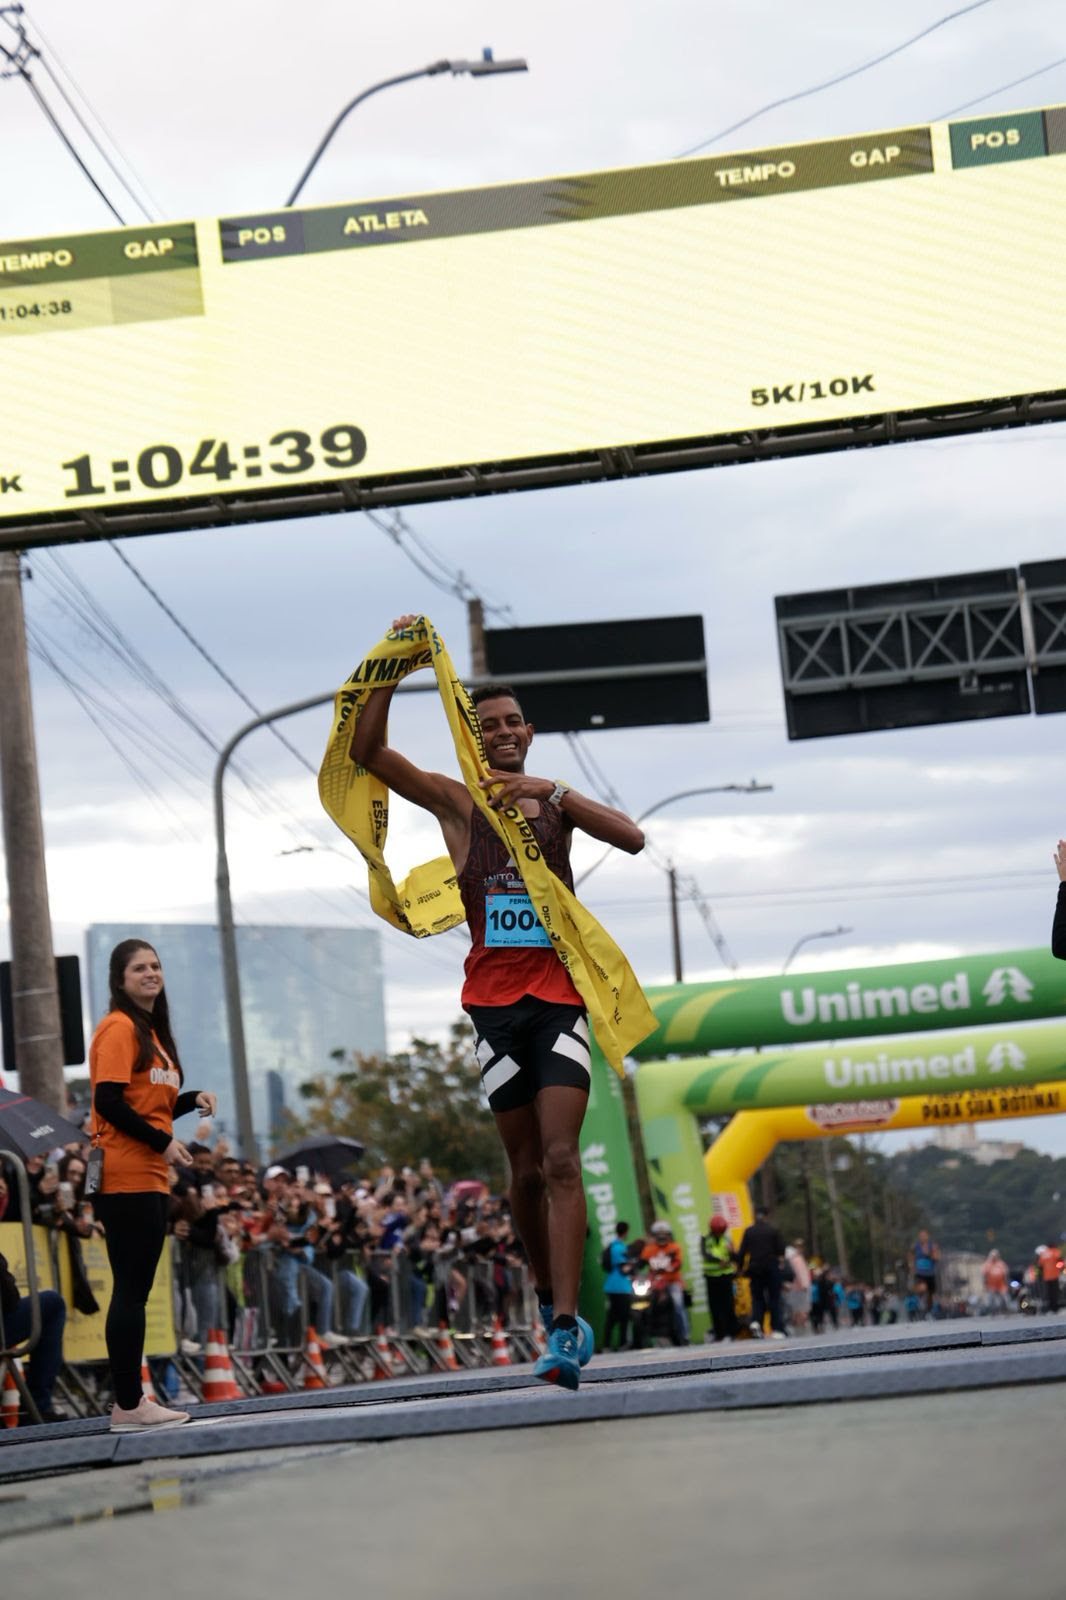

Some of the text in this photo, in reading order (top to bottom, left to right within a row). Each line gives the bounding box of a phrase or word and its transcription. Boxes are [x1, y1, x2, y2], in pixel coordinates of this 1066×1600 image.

[970, 128, 1021, 151] POS
[715, 145, 901, 187] TEMPO GAP
[237, 208, 430, 246] POS ATLETA
[124, 237, 175, 259] GAP
[750, 373, 877, 407] 5K/10K
[61, 423, 368, 498] 1:04:39
[780, 972, 971, 1026] Unimed
[824, 1044, 977, 1089] Unimed
[922, 1103, 961, 1120] PARA
[966, 1098, 994, 1117] SUA
